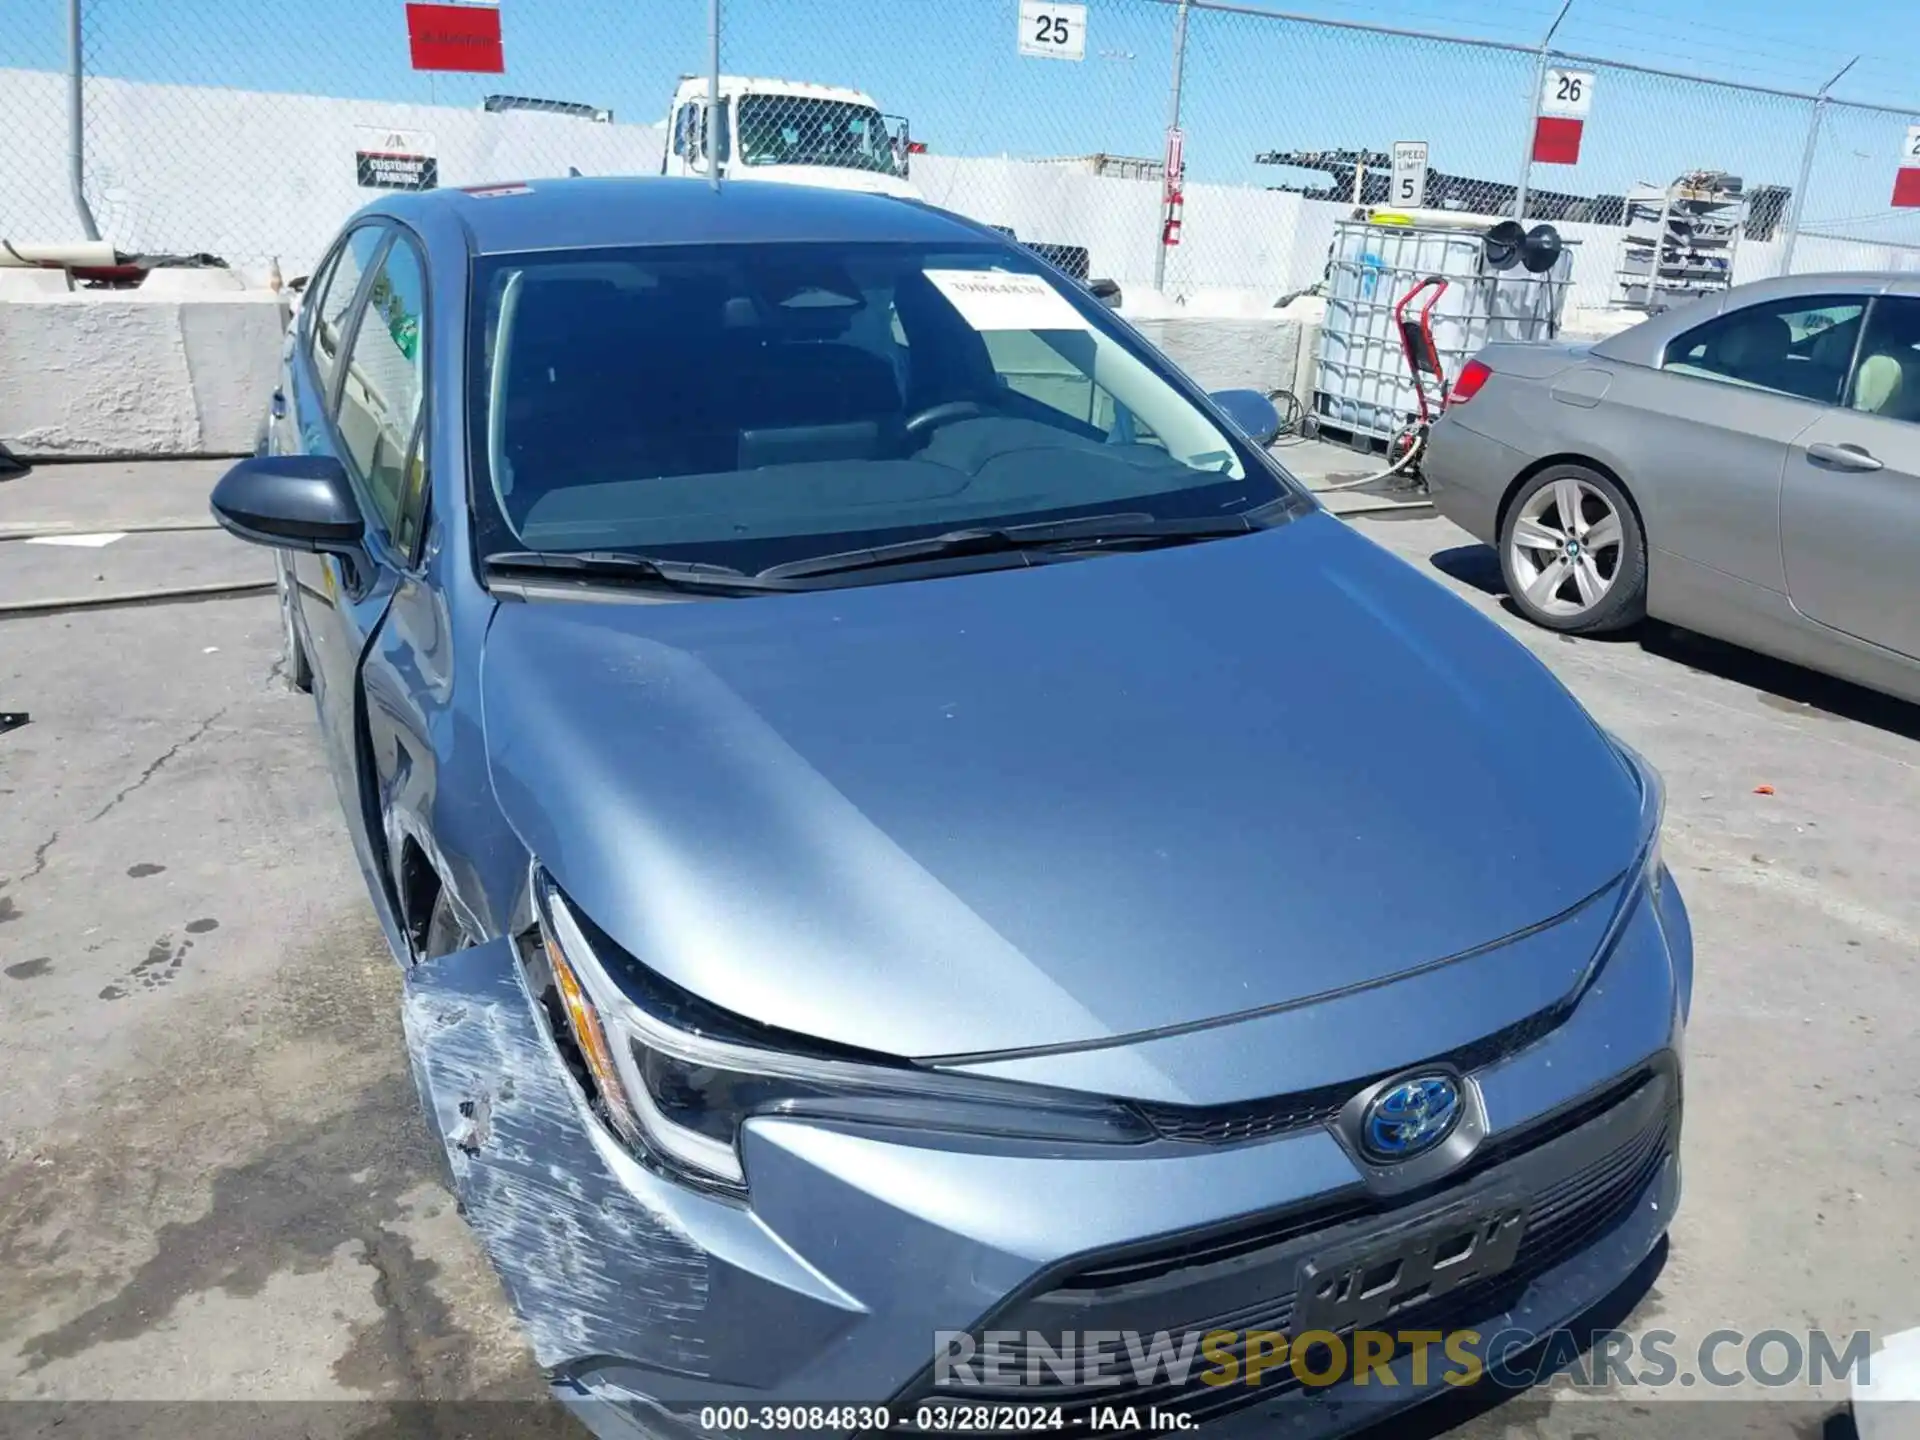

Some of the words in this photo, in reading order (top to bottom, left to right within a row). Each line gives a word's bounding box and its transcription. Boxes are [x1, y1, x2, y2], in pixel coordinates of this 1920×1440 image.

[1035, 14, 1069, 44] 25
[1556, 76, 1582, 102] 26
[1396, 150, 1425, 160] SPEED
[1912, 135, 1920, 155] 2
[1398, 161, 1422, 171] LIMIT
[1401, 179, 1414, 199] 5
